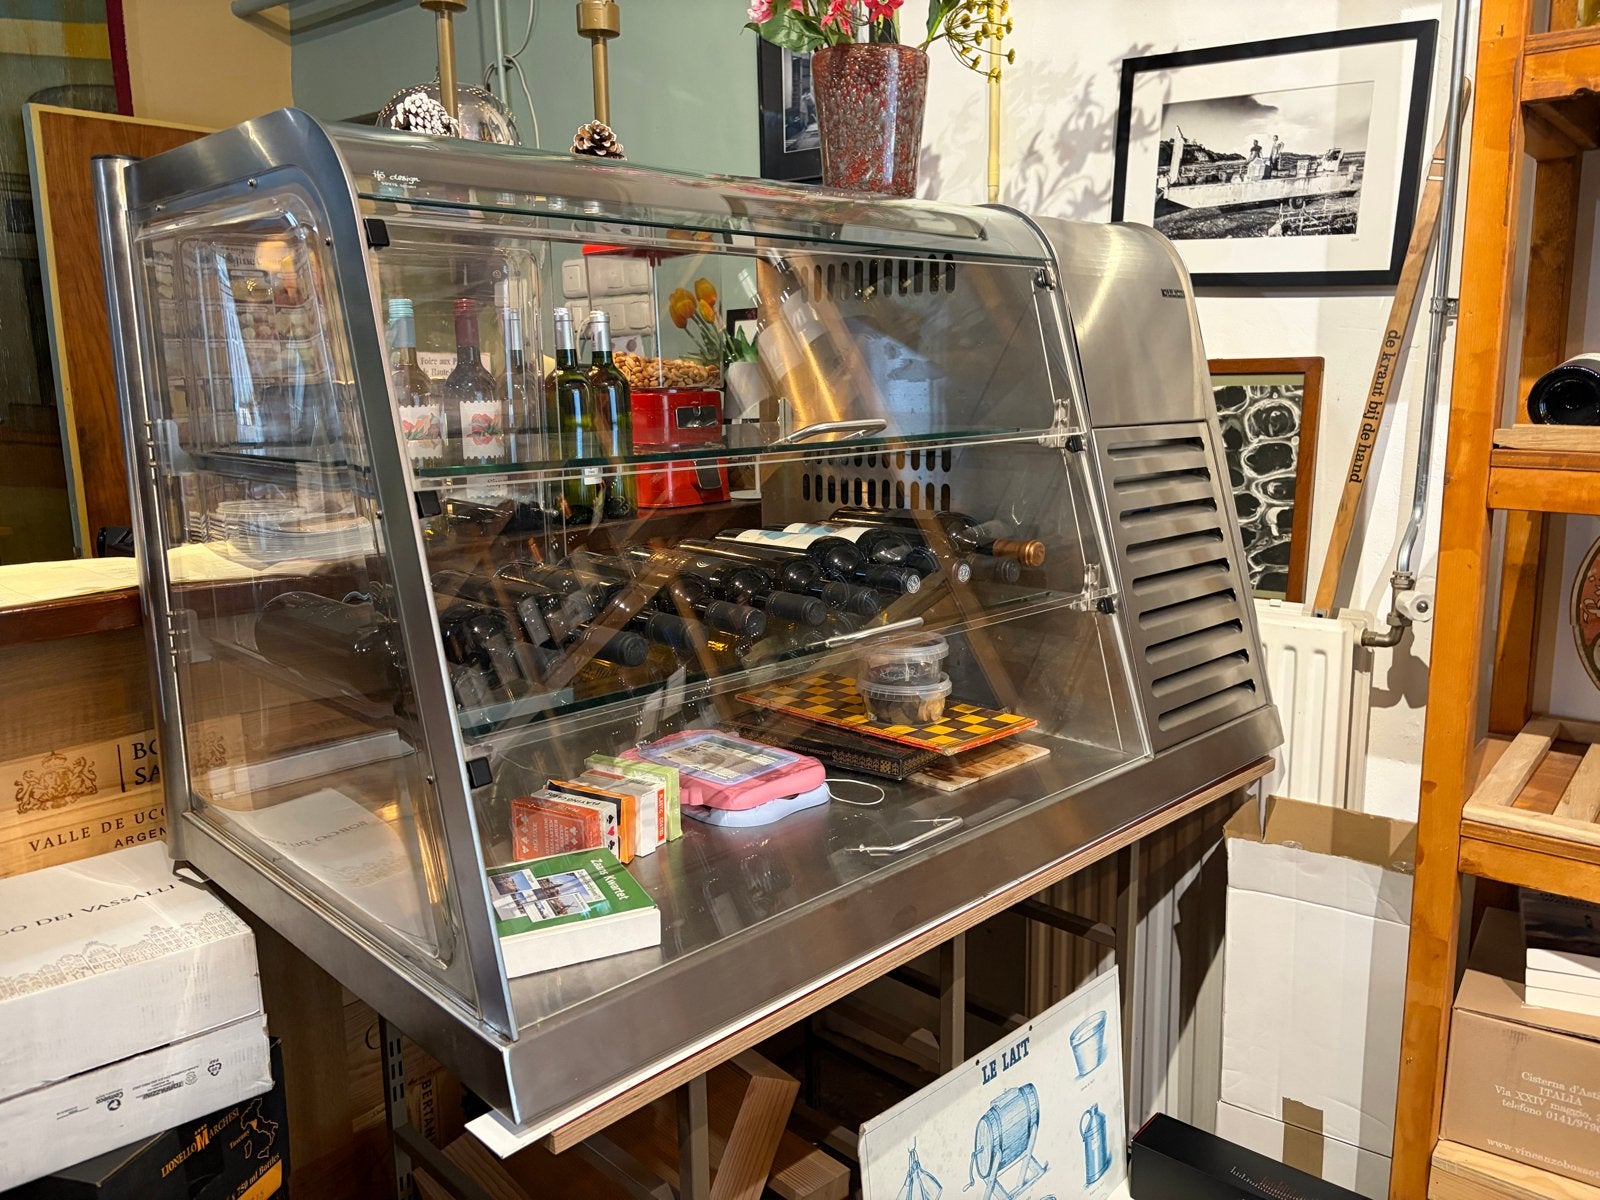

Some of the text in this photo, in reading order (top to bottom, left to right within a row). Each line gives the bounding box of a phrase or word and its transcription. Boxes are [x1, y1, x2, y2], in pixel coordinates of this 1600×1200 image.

[389, 174, 421, 185] design
[1349, 329, 1401, 483] de krant bij de hand
[566, 798, 601, 807] PLAYING
[29, 827, 92, 852] VALLE
[101, 818, 126, 834] DE
[590, 858, 630, 900] Zaans Kwartet
[36, 912, 75, 926] DEI
[81, 884, 176, 913] VASSALLI
[981, 1037, 1030, 1085] LE LAIT
[1521, 1071, 1565, 1091] Cisterna
[1539, 1086, 1583, 1106] ITALIA
[1494, 1084, 1512, 1097] Via
[1515, 1091, 1548, 1106] XXIV
[1550, 1102, 1593, 1121] maggio,
[1502, 1099, 1543, 1116] telefono
[161, 1107, 240, 1178] LIONELLO MARCHESI
[259, 1153, 280, 1176] Bottles
